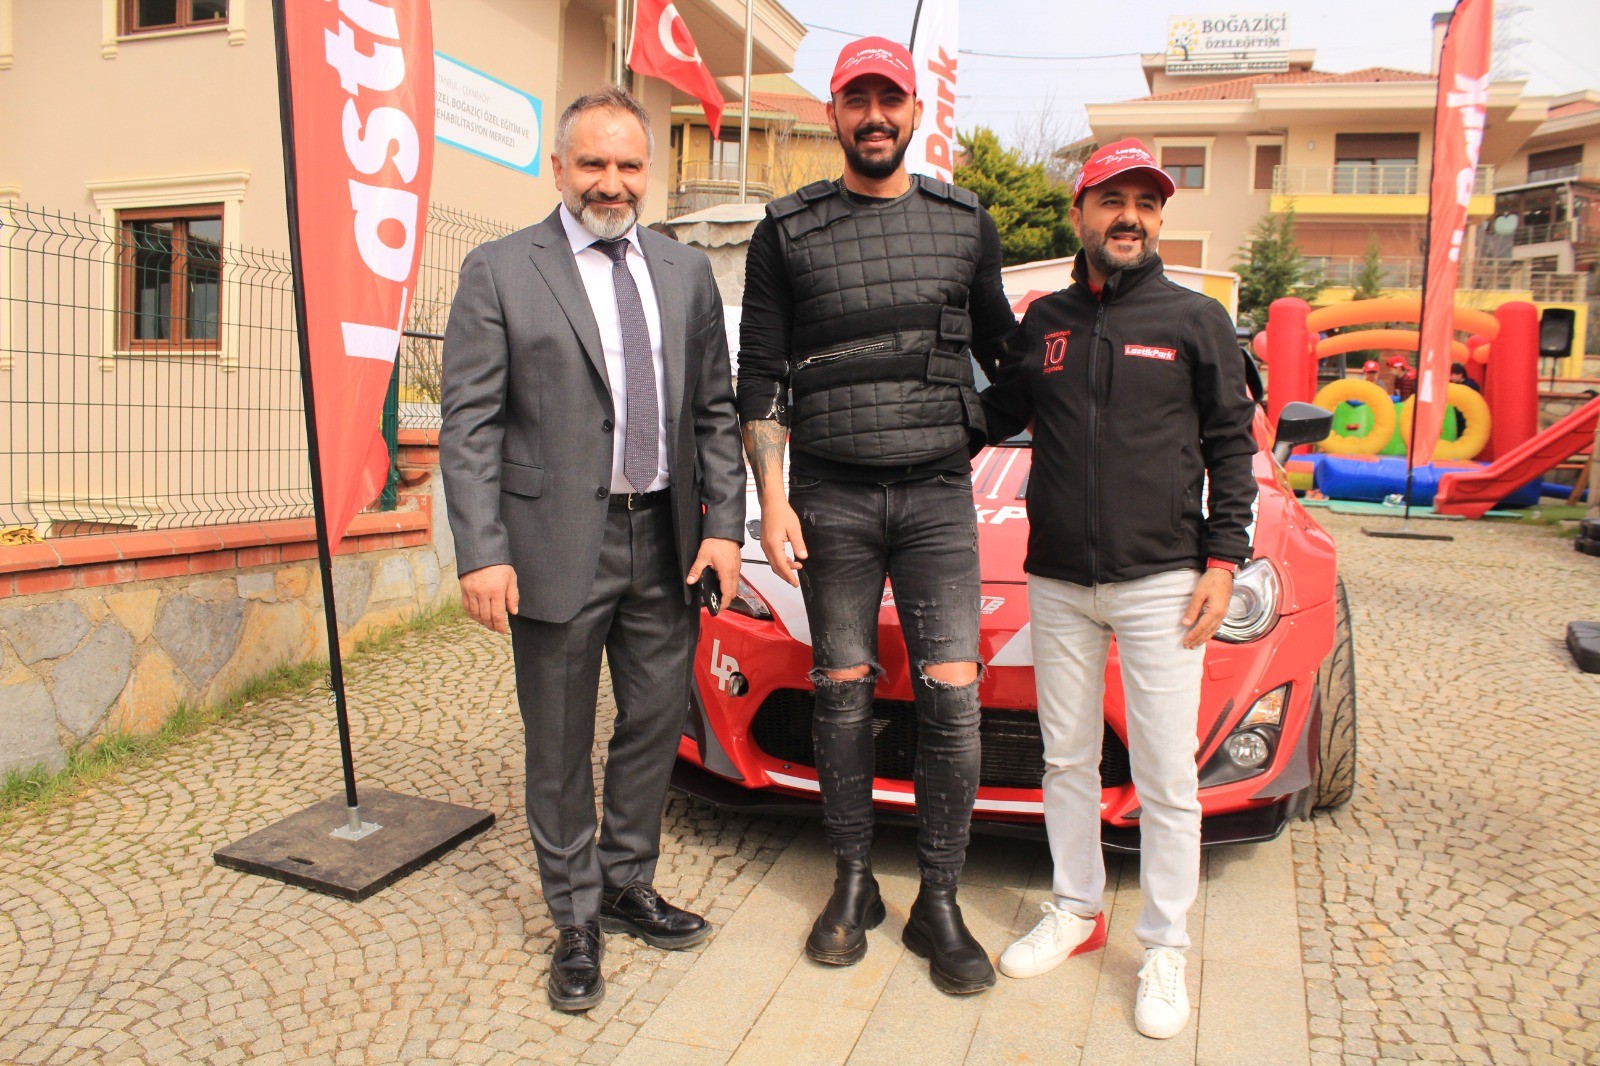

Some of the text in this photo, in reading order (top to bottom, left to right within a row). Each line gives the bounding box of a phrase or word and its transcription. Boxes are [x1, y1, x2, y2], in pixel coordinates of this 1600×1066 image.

[1202, 13, 1287, 34] BOĞAZİÇİ
[434, 107, 515, 148] EHABİLİTASYON MERKEZİ
[451, 97, 483, 121] BOĞAZİÇİ
[483, 109, 500, 127] ÖZEL
[500, 117, 521, 136] EĞİTİM
[521, 127, 530, 139] VE
[1043, 337, 1068, 367] 10
[1125, 346, 1173, 360] LastikPark
